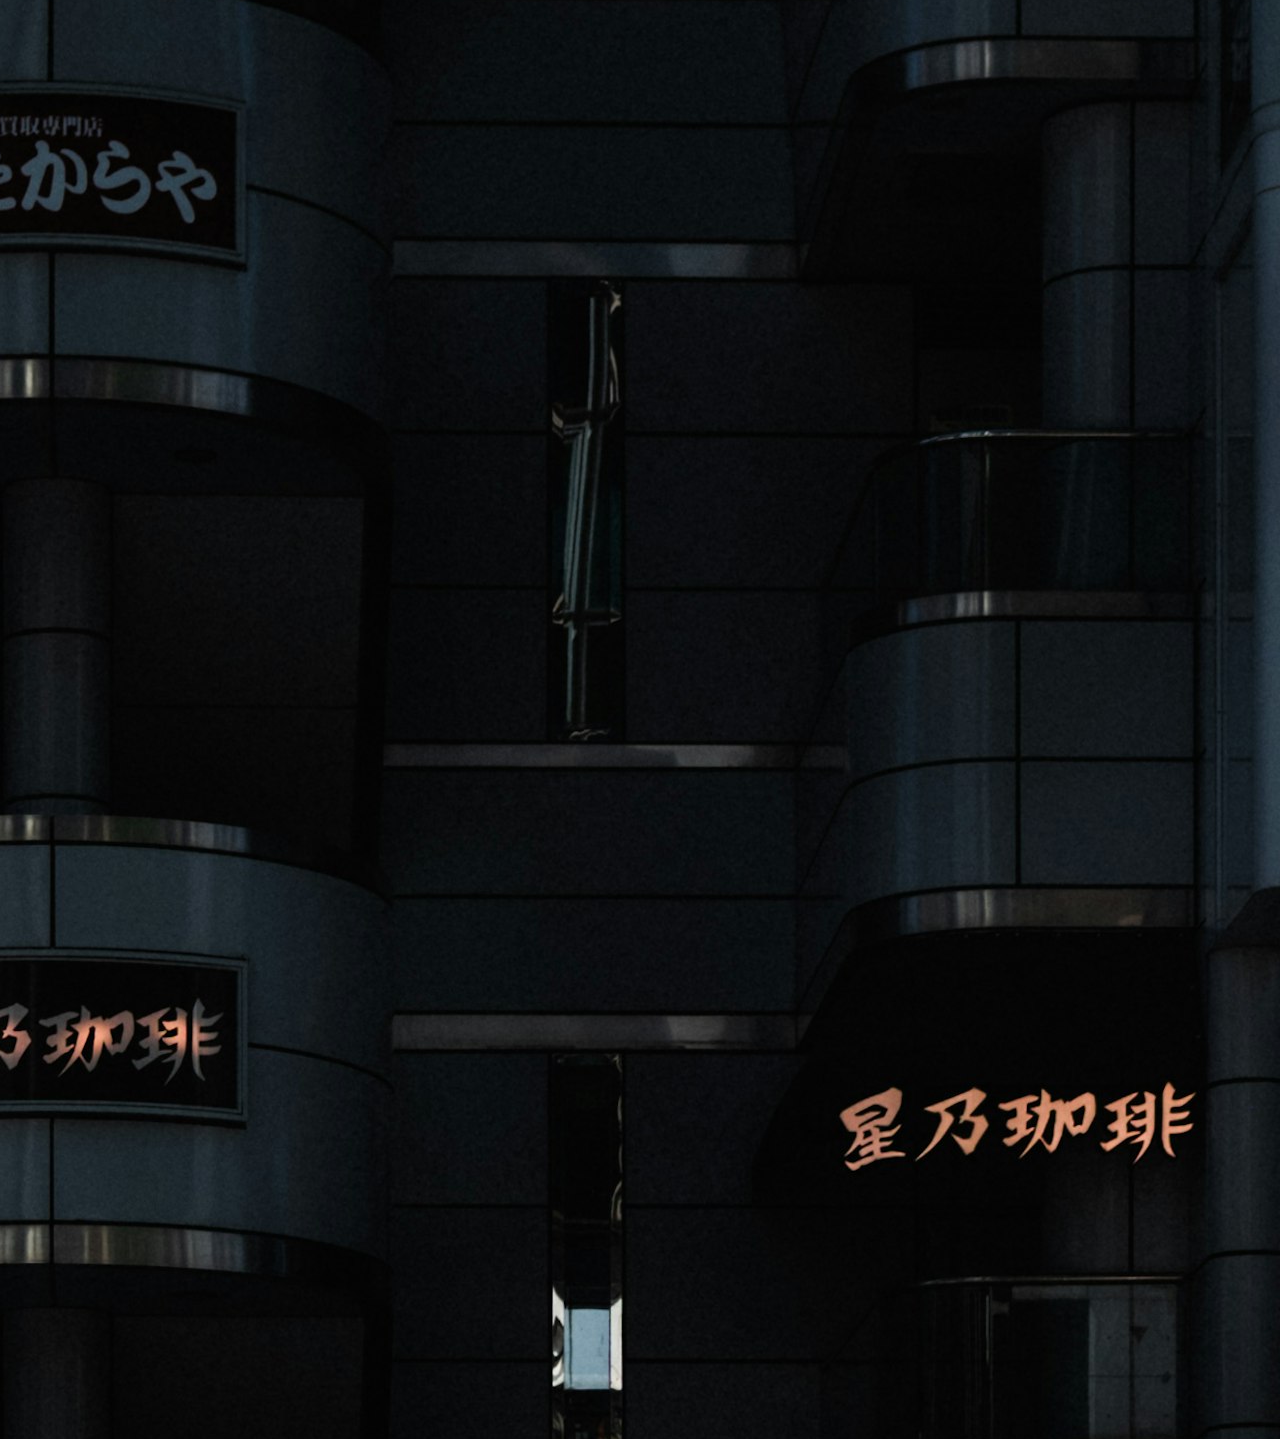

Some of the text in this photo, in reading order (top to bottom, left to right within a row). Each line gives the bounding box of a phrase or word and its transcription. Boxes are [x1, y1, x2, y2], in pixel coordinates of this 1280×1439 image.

[0, 114, 104, 138] 買取専門店
[838, 1081, 1197, 1172] 星乃珈琲
